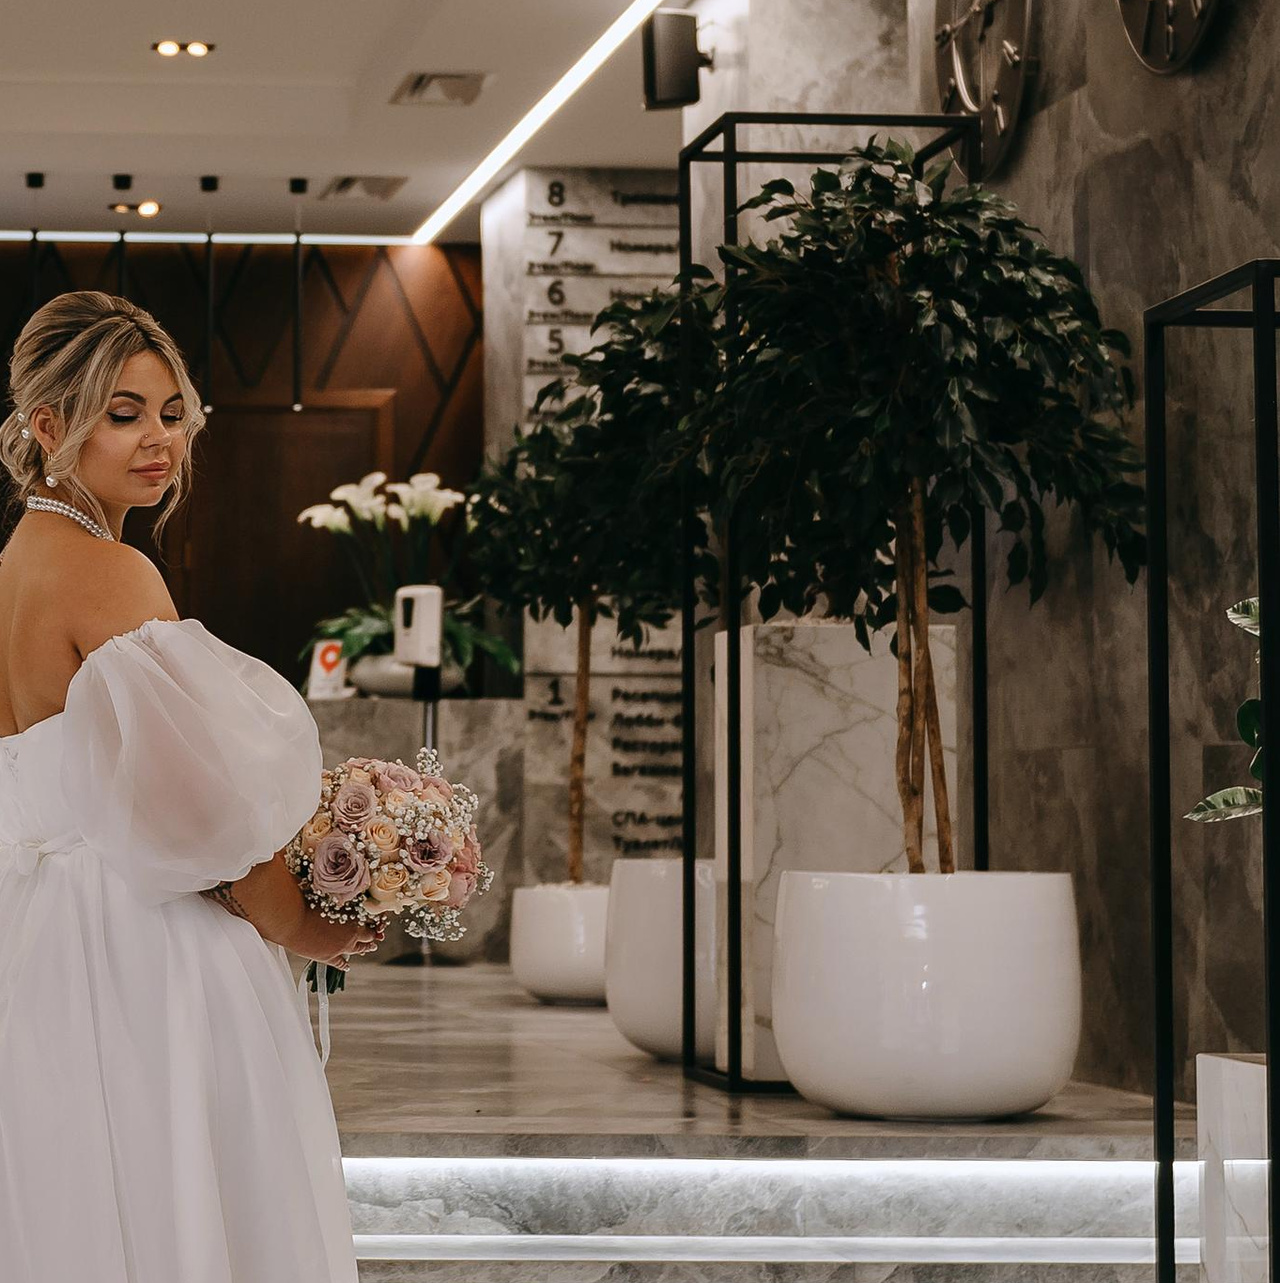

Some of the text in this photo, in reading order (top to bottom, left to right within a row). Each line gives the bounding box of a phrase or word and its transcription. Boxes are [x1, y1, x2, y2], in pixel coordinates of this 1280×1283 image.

[548, 181, 565, 206] 8
[548, 231, 564, 256] 7
[547, 280, 565, 306] 6
[548, 328, 564, 355] 5
[548, 678, 564, 705] 1
